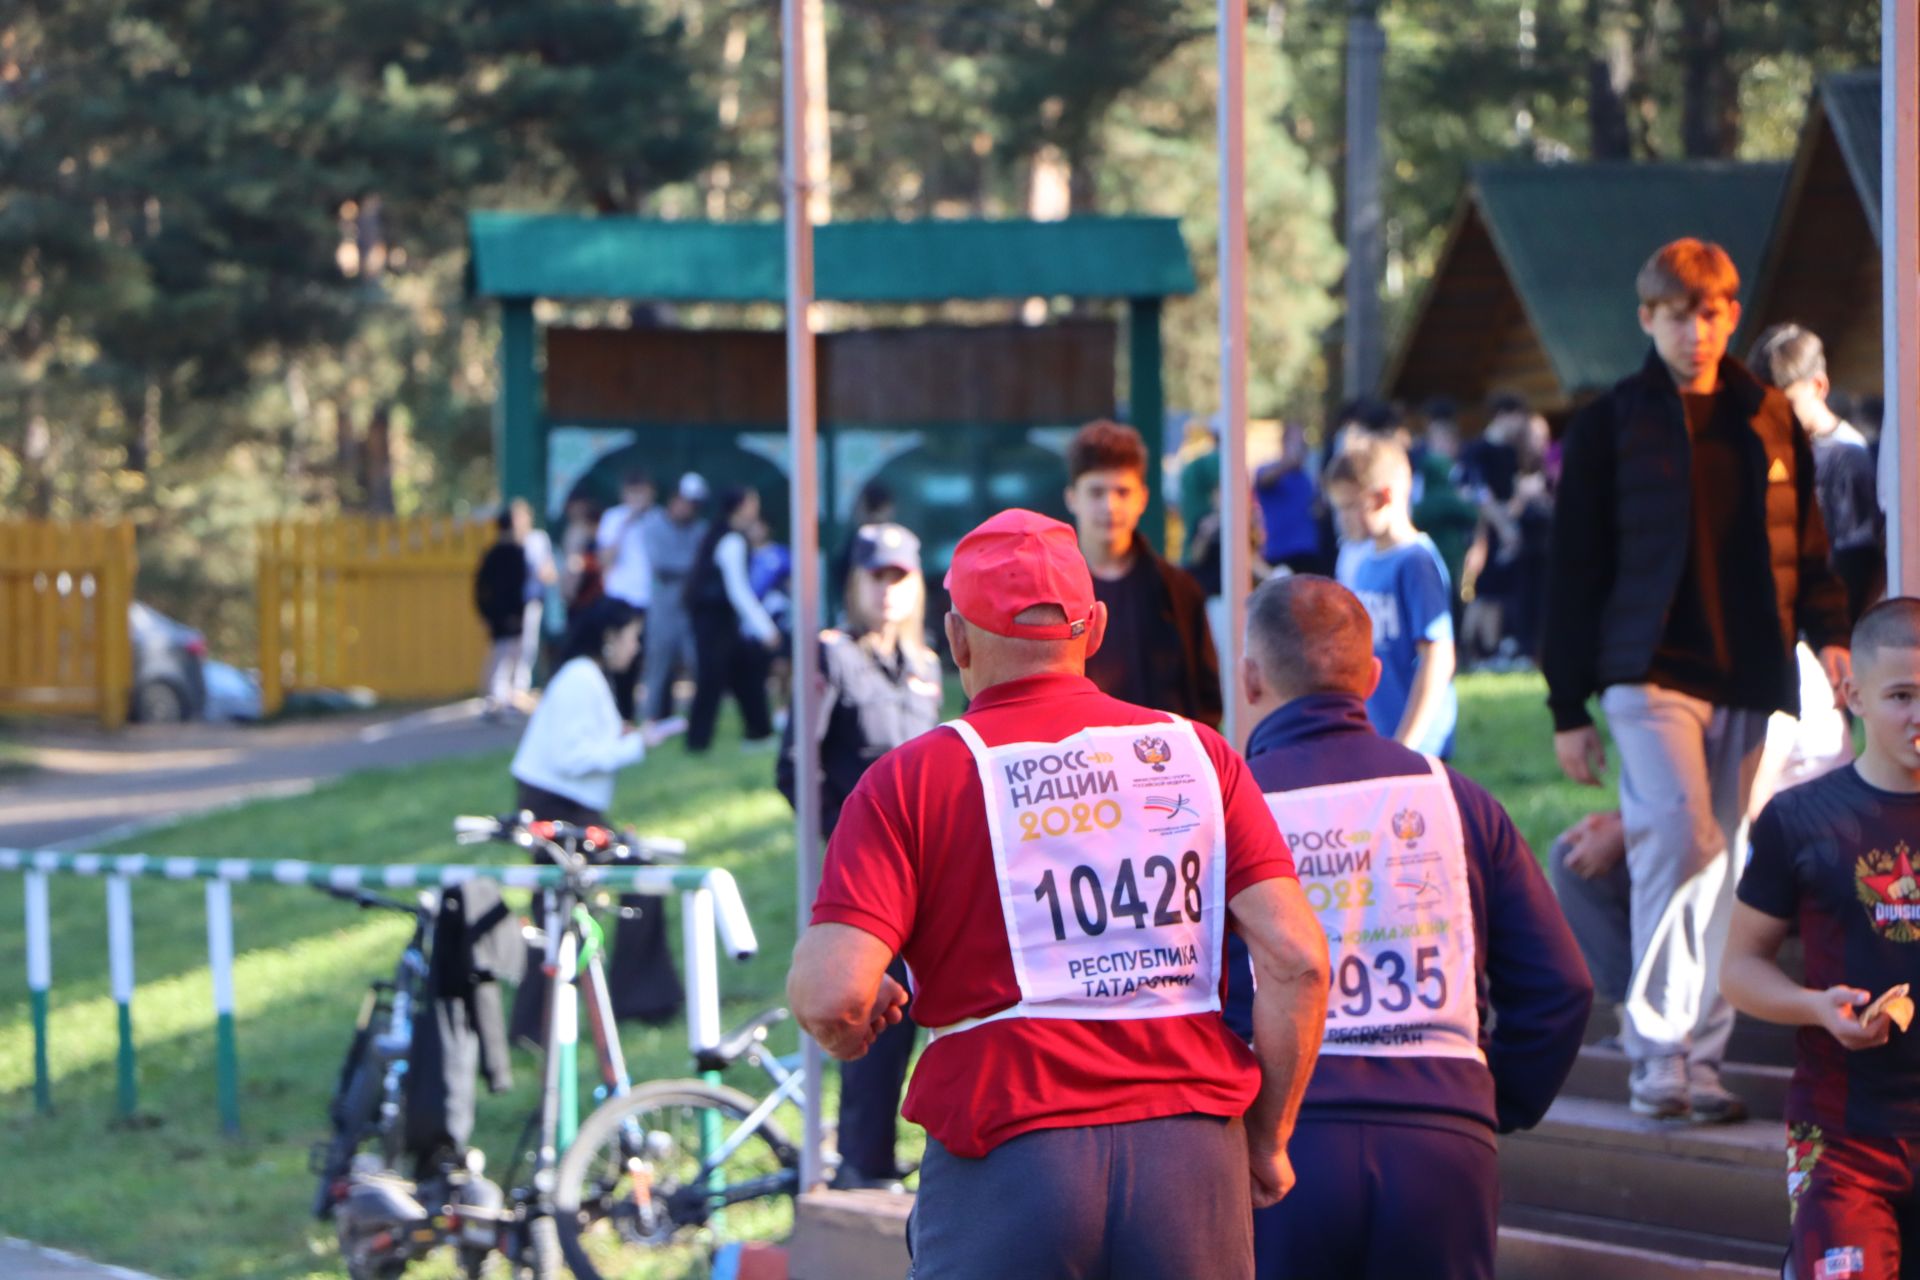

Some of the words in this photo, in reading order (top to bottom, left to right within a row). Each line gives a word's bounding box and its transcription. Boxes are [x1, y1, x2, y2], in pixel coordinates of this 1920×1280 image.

[1004, 750, 1090, 785] КРОСС
[1010, 769, 1119, 808] НАЦИИ
[1018, 799, 1122, 842] 2020
[1287, 829, 1348, 853] РОСС
[1297, 850, 1372, 878] АЦИИ
[1034, 849, 1202, 941] 10428
[1304, 878, 1376, 912] 022
[1068, 944, 1199, 979] РЕСПУБЛИКА
[1327, 946, 1447, 1019] 935
